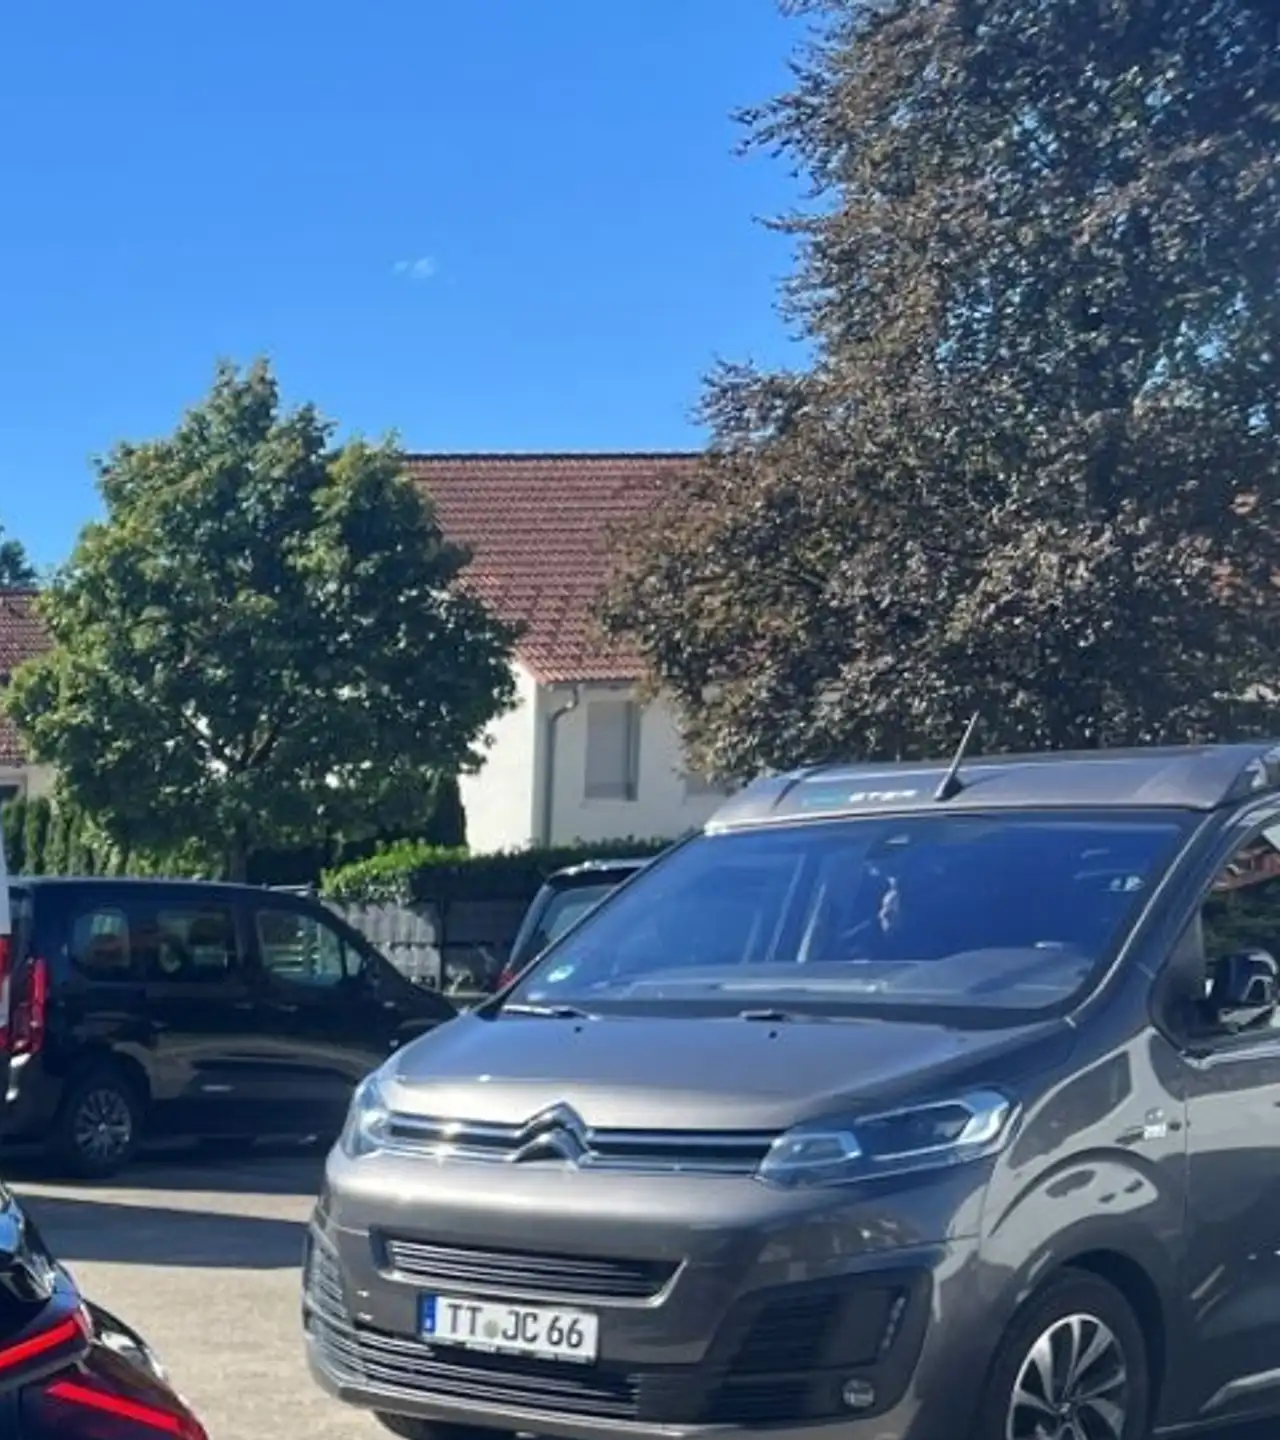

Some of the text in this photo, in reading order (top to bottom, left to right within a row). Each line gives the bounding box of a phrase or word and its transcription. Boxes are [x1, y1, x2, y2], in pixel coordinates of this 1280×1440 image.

[447, 1303, 584, 1349] TT JC 66
